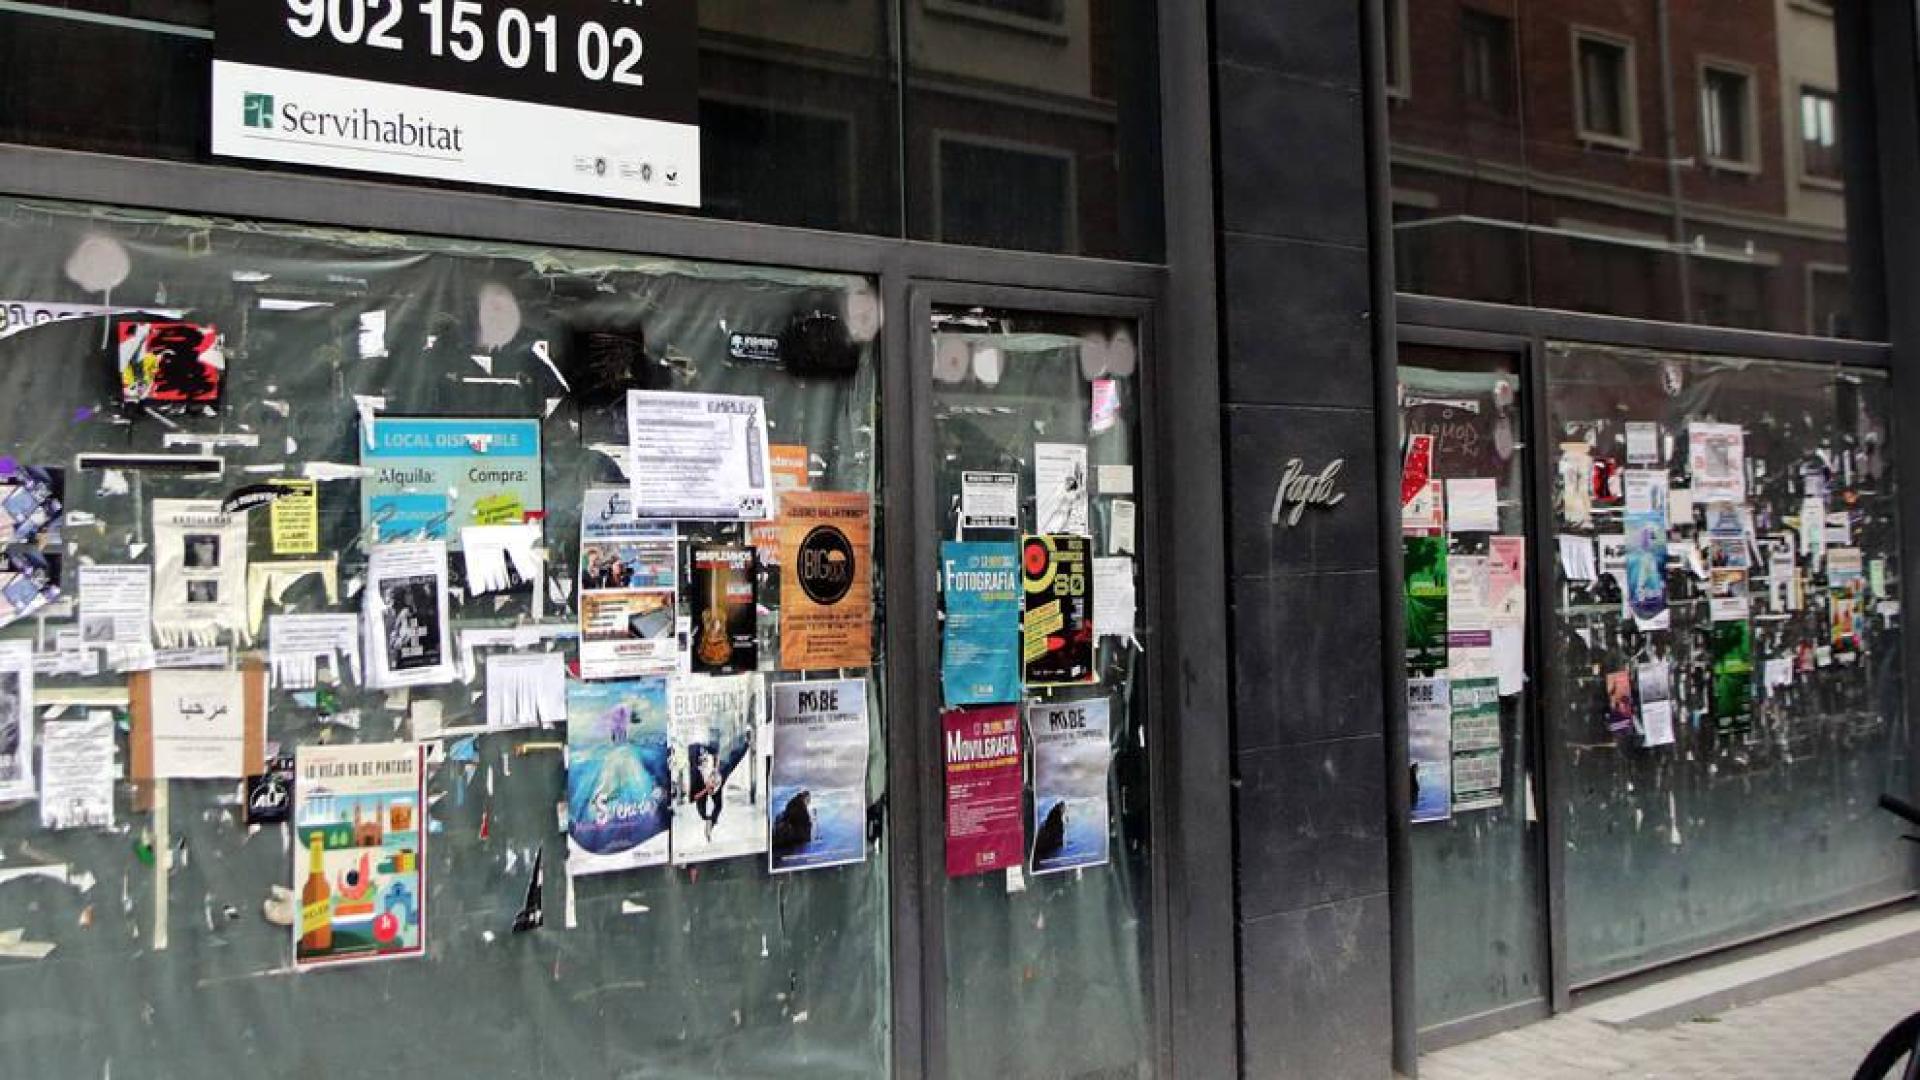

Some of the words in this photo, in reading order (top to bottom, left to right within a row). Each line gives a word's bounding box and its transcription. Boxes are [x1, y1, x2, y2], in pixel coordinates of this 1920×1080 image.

[287, 0, 403, 50] 902
[420, 0, 484, 62] 15
[497, 7, 557, 73] 01
[577, 21, 644, 86] 02
[281, 102, 463, 152] Servihabitat
[384, 434, 431, 448] LOCAL
[469, 467, 528, 484] Compra:
[798, 689, 839, 713] ROBE
